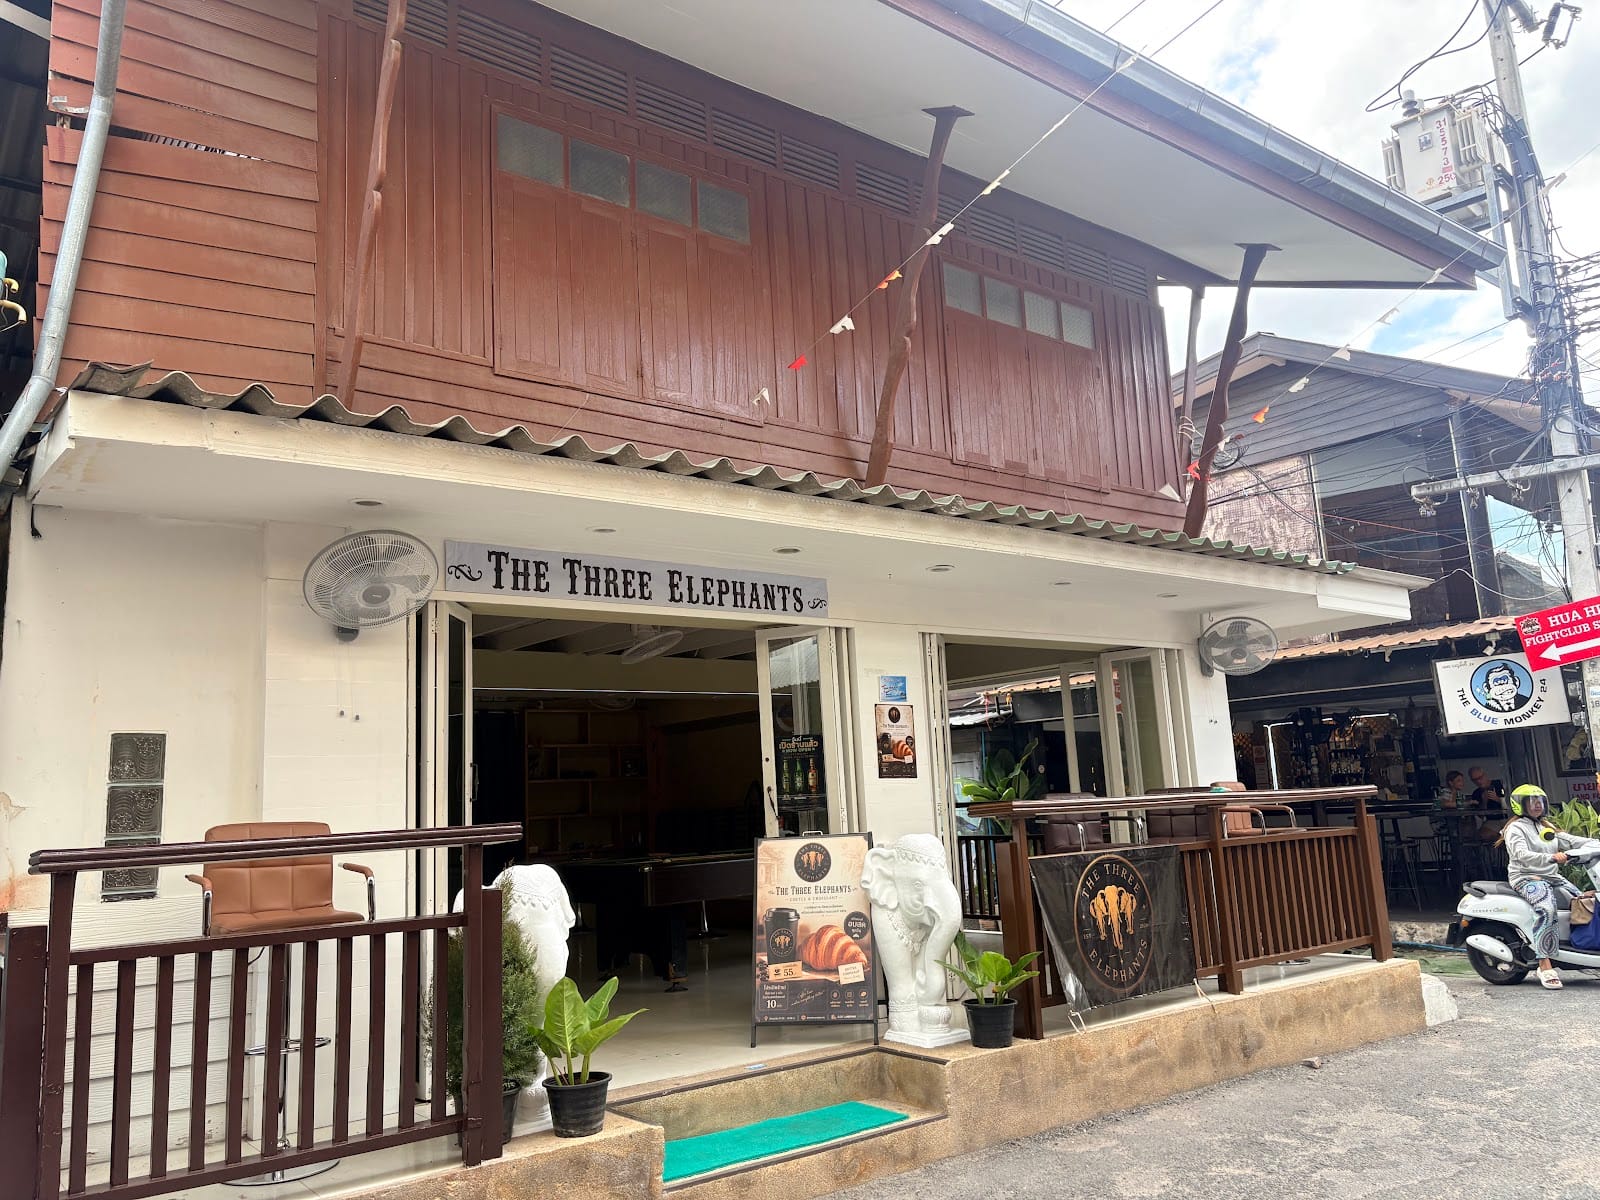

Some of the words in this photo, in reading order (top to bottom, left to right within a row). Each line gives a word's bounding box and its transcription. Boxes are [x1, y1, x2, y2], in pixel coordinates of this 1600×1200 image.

[487, 550, 549, 593] THE
[562, 557, 653, 601] THREE
[666, 568, 804, 613] ELEPHANTS
[1547, 610, 1583, 627] HUA
[1524, 623, 1591, 648] FIGHTCLUB
[1457, 687, 1471, 707] THE
[1470, 707, 1499, 725] BLUE
[1503, 696, 1545, 726] MONKEY
[1539, 678, 1548, 693] 24
[1081, 869, 1100, 898] THE
[1103, 863, 1140, 894] THREE
[783, 968, 794, 977] 55
[1089, 939, 1148, 982] ELEPHANTS
[766, 999, 777, 1009] 10
